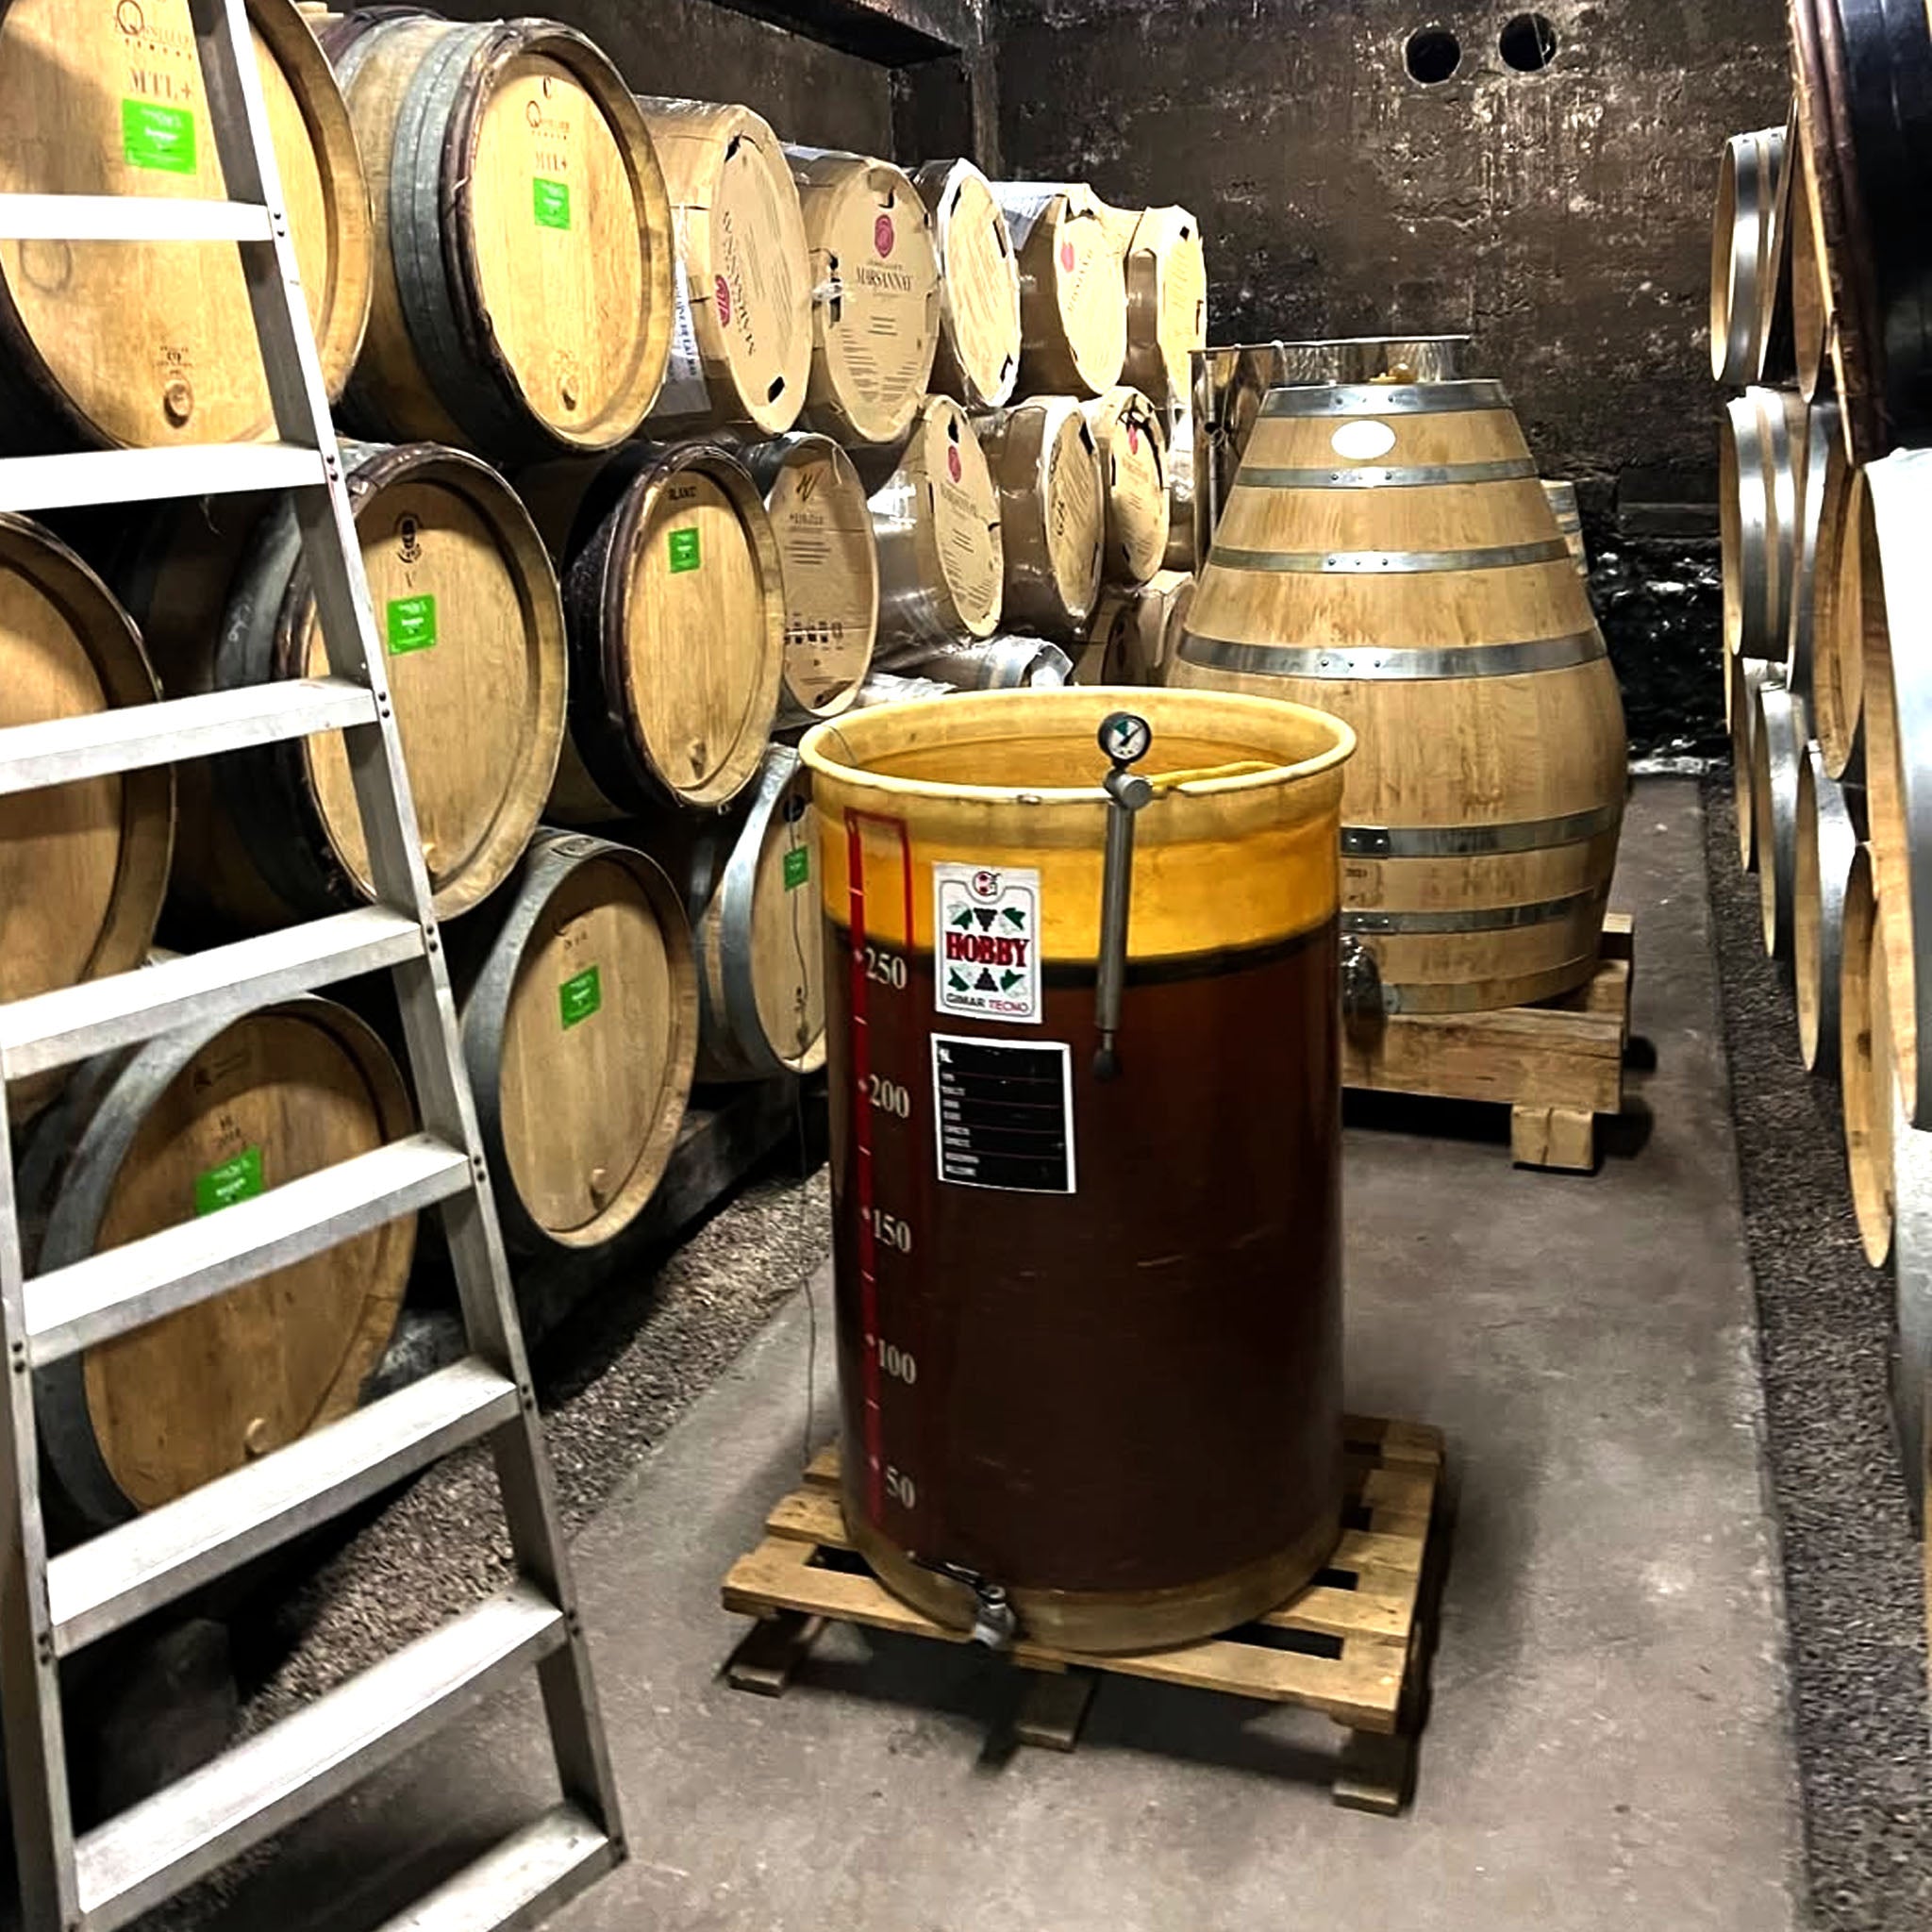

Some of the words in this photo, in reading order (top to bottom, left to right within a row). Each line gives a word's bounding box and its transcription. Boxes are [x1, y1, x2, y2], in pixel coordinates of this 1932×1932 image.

[865, 947, 908, 990] 250
[945, 931, 1030, 968] HOBBY
[989, 999, 1029, 1013] TECNO
[868, 1074, 910, 1120] 200
[874, 1209, 912, 1254] 150
[878, 1339, 917, 1385] 100
[886, 1465, 916, 1508] 50
